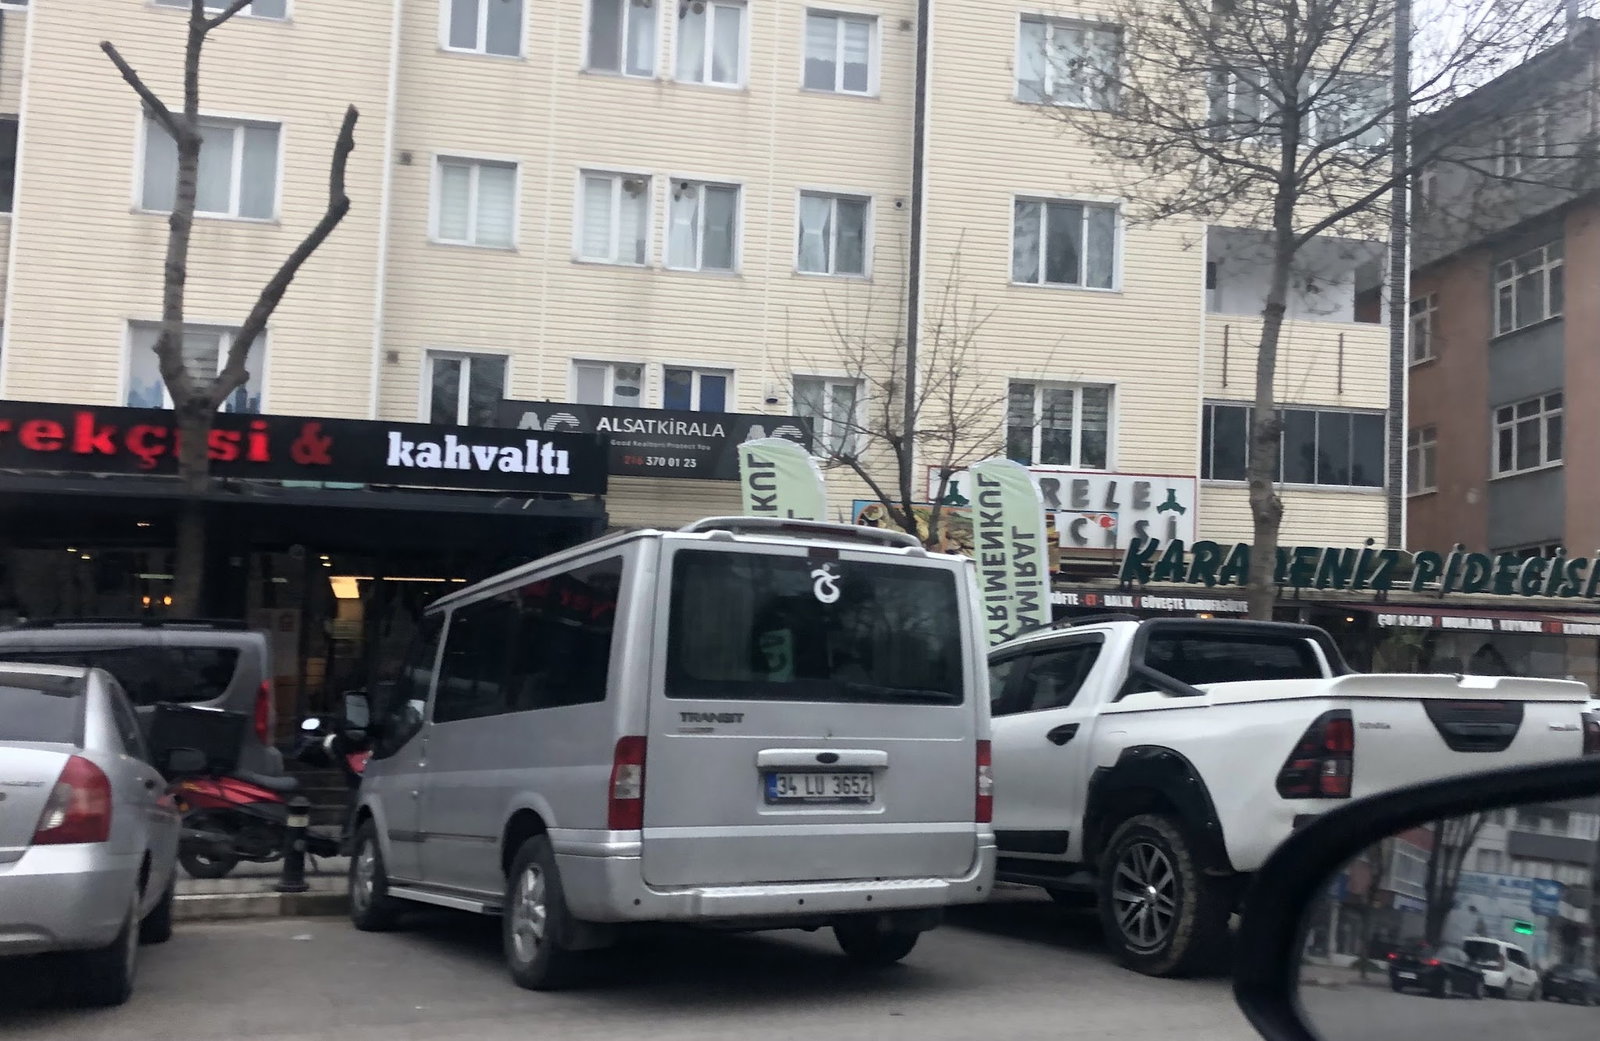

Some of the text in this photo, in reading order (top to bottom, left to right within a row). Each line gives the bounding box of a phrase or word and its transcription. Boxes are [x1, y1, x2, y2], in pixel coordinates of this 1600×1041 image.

[596, 416, 726, 438] ALSATKİRALA
[0, 411, 332, 469] ekçsi &
[387, 431, 570, 475] kahvaltı
[645, 456, 666, 468] 370
[667, 457, 681, 468] 01
[680, 711, 745, 724] TRANSIT
[778, 775, 870, 796] 34 LU 3652
